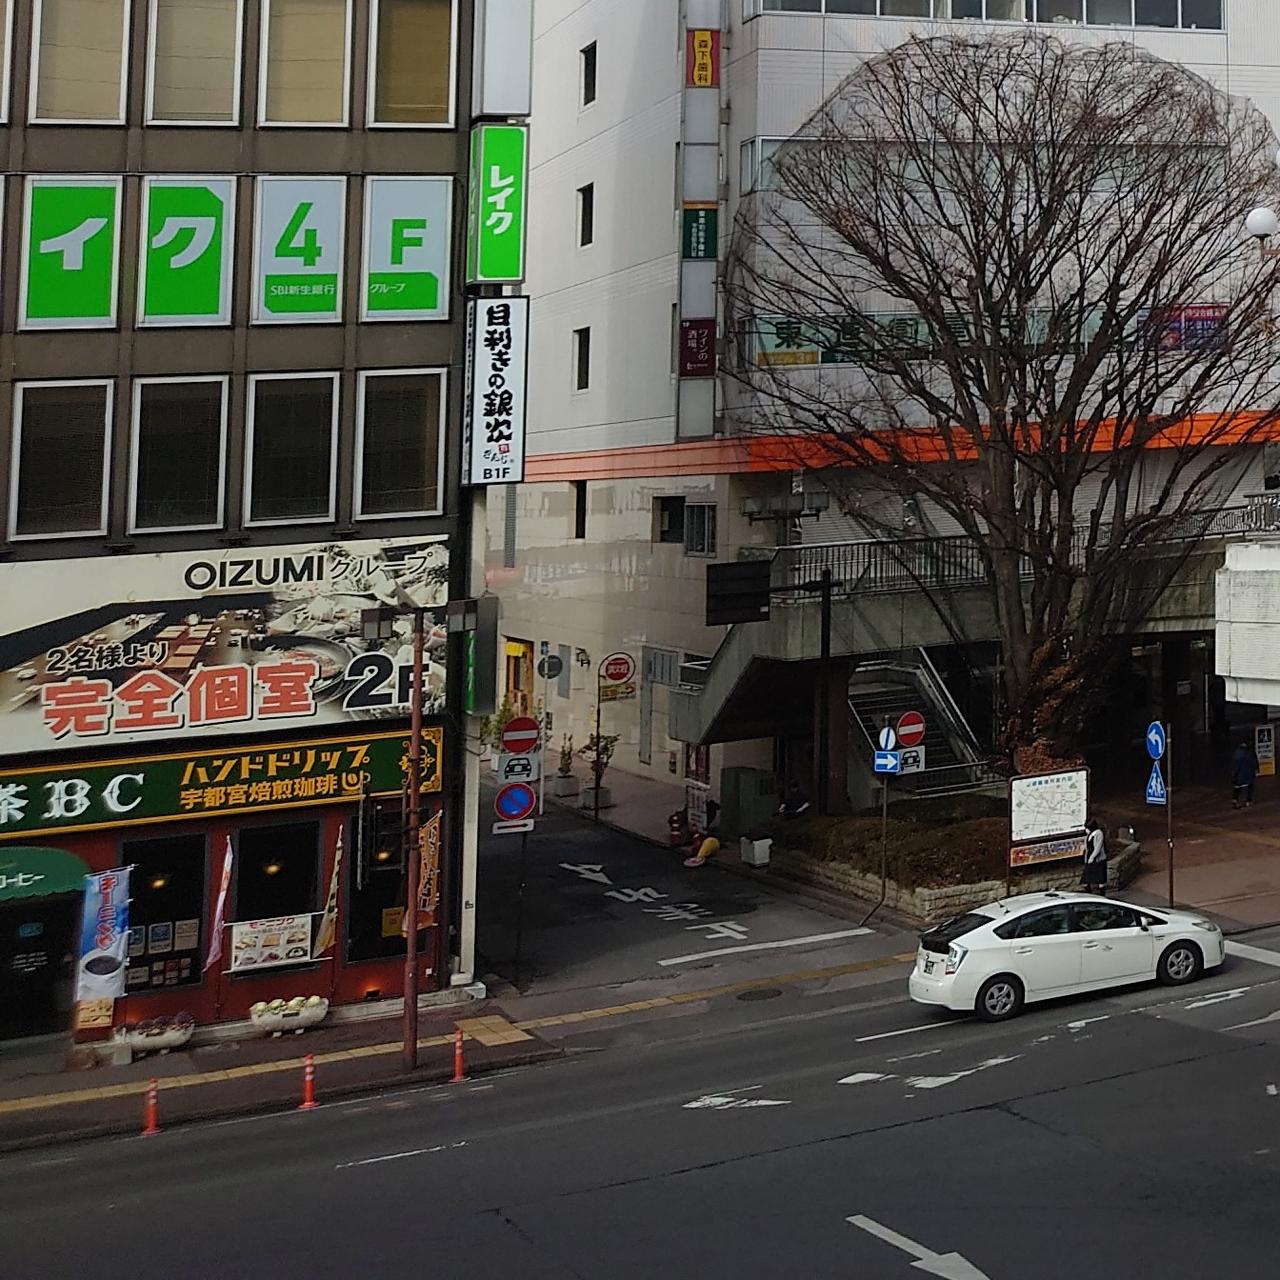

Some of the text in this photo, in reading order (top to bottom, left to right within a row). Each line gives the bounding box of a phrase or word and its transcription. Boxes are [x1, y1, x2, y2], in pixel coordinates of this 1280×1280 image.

[486, 165, 515, 235] レイク
[482, 303, 514, 444] 目利きの銀次
[483, 468, 510, 480] B1F
[183, 551, 434, 591] OIZUMIグループ
[46, 639, 169, 674] 2名様より
[43, 658, 319, 739] 完全個室
[180, 744, 371, 786] ハンドドリップ
[181, 776, 336, 809] 宇都宮焙煎珈琲
